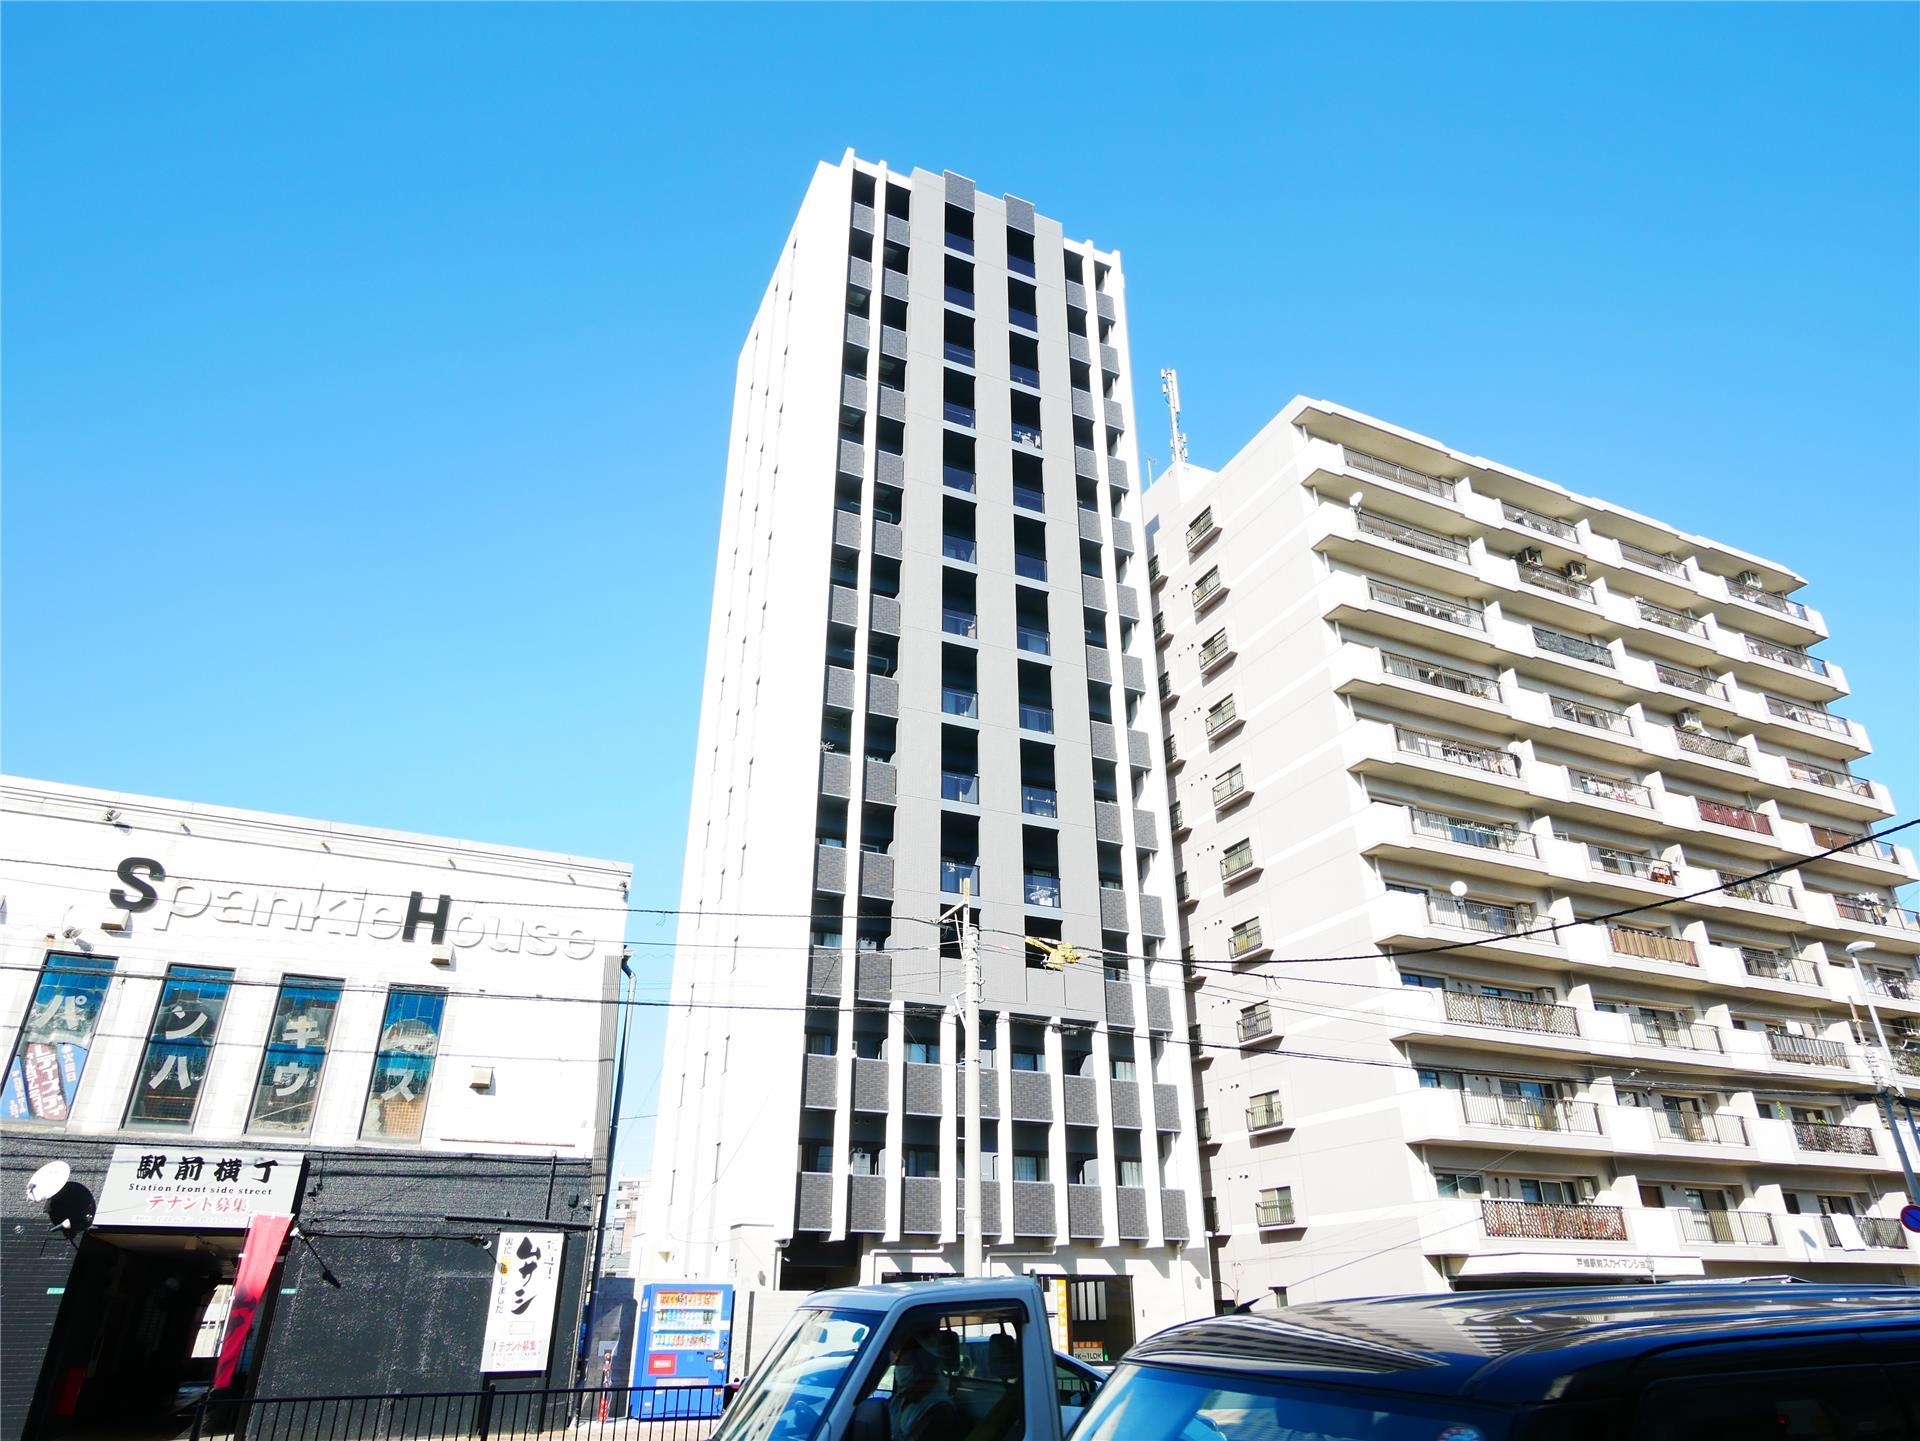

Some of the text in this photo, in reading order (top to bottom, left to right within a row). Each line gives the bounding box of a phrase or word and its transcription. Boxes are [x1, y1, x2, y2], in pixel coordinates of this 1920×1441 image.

[136, 1154, 279, 1184] 駅前横丁
[128, 1183, 273, 1196] Station front side street
[148, 1194, 248, 1213] テナント募集
[511, 1236, 541, 1315] ムサシ
